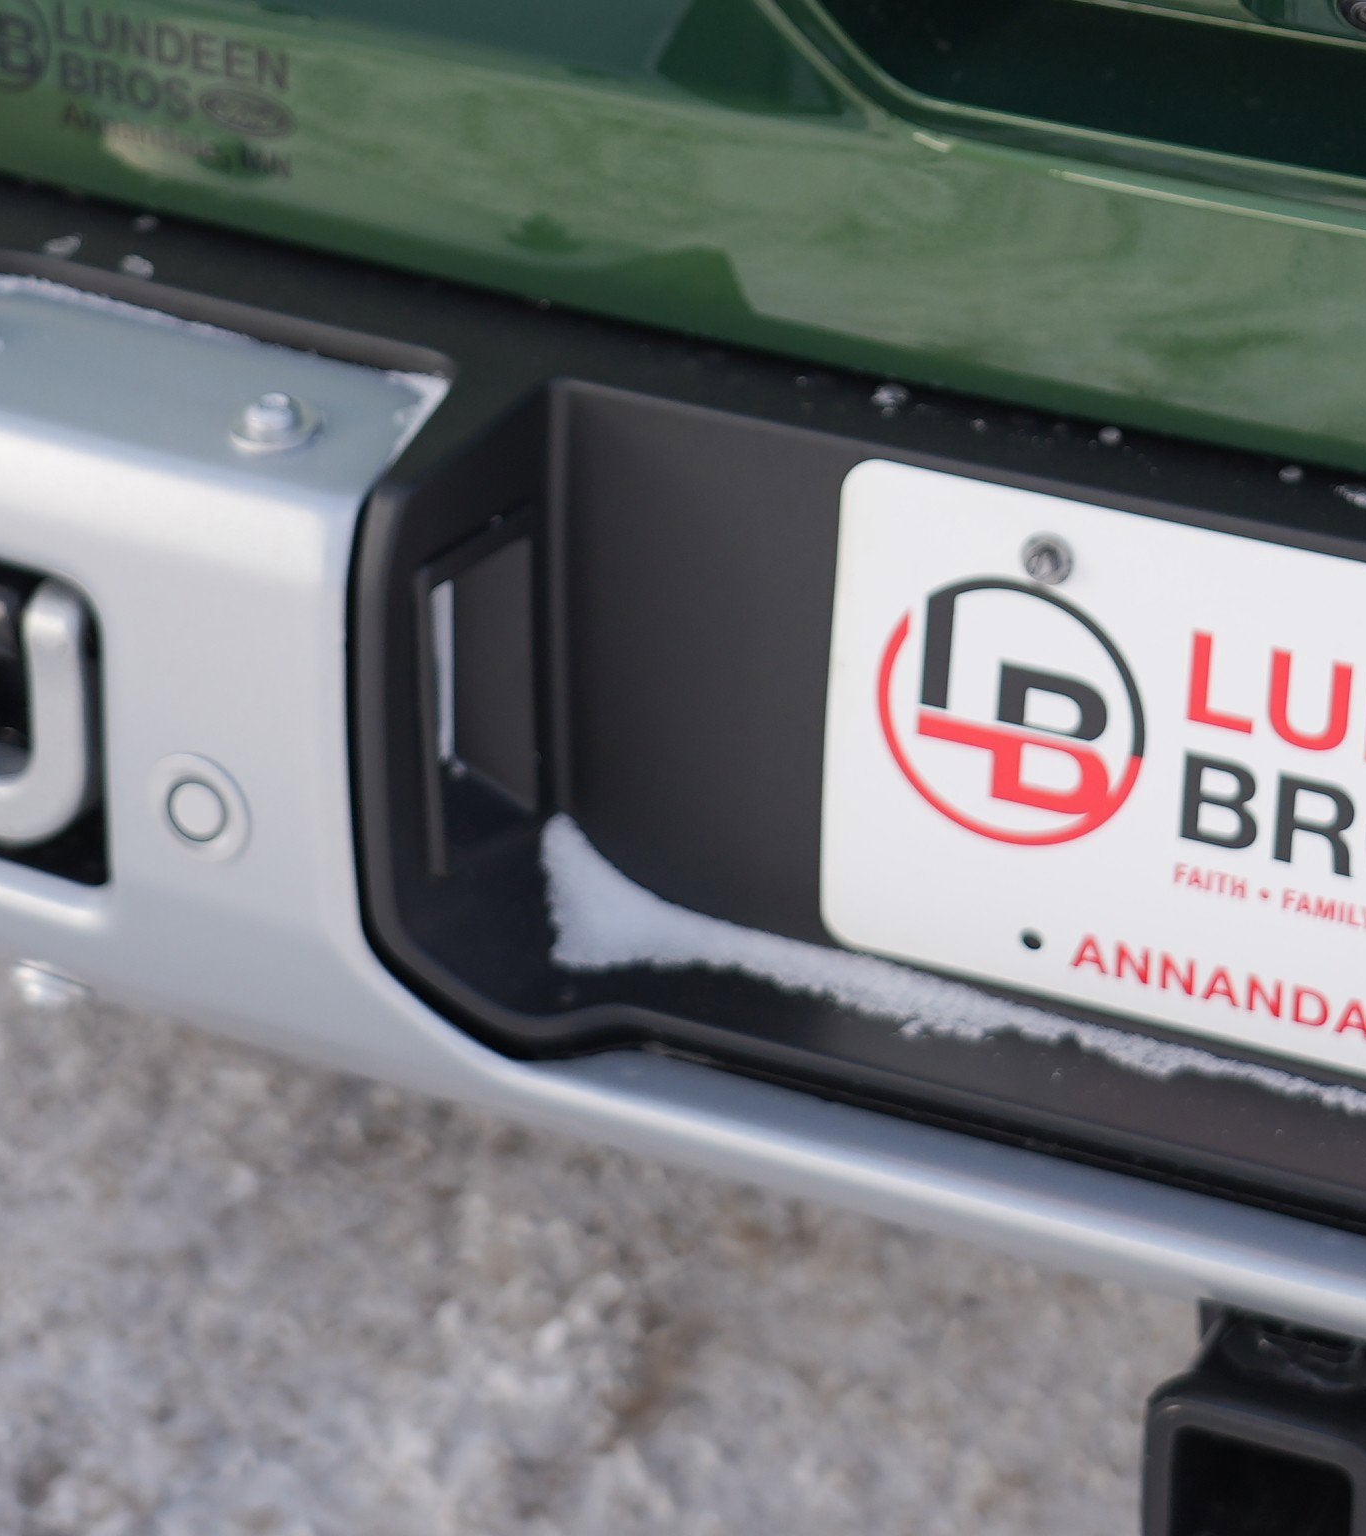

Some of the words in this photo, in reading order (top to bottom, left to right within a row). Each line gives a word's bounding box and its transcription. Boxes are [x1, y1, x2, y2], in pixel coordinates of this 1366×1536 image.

[53, 0, 290, 93] LUNDEEN
[59, 51, 192, 122] BROS
[1173, 862, 1247, 900] FAITH
